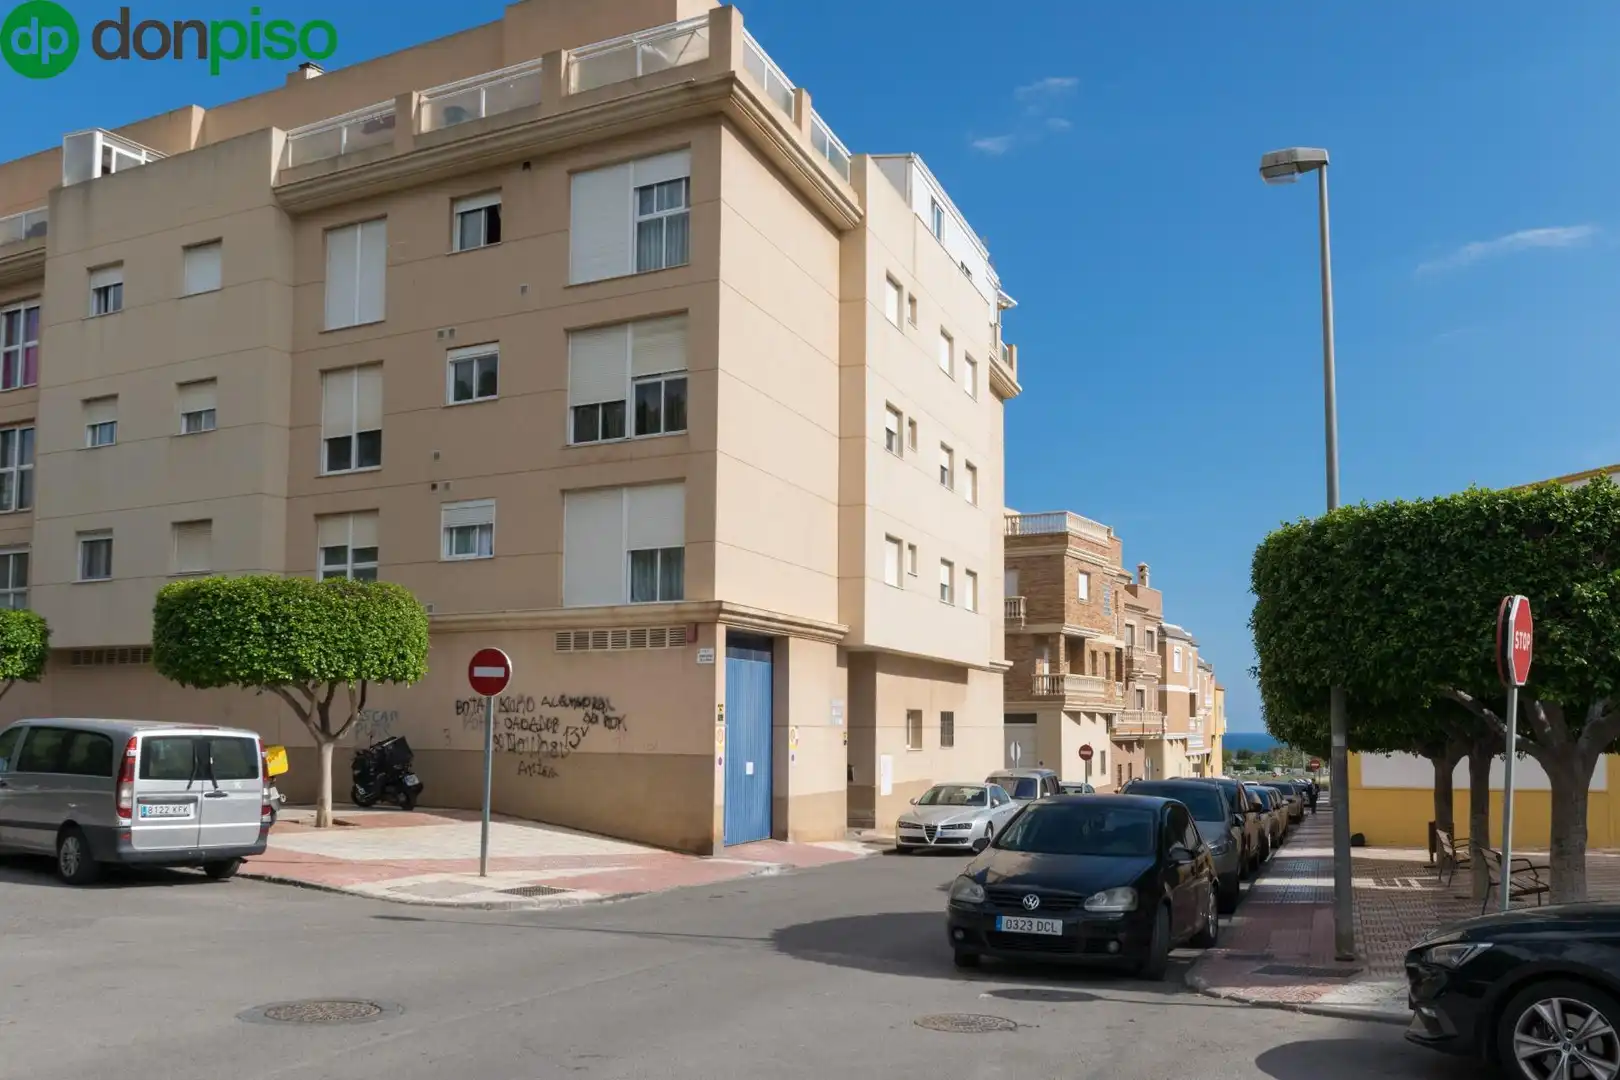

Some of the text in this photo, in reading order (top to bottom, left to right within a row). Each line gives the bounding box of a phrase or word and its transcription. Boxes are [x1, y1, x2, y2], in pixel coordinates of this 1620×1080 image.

[1514, 630, 1531, 651] STOP
[148, 806, 170, 815] 8122
[1005, 919, 1058, 934] 0323 DCL
